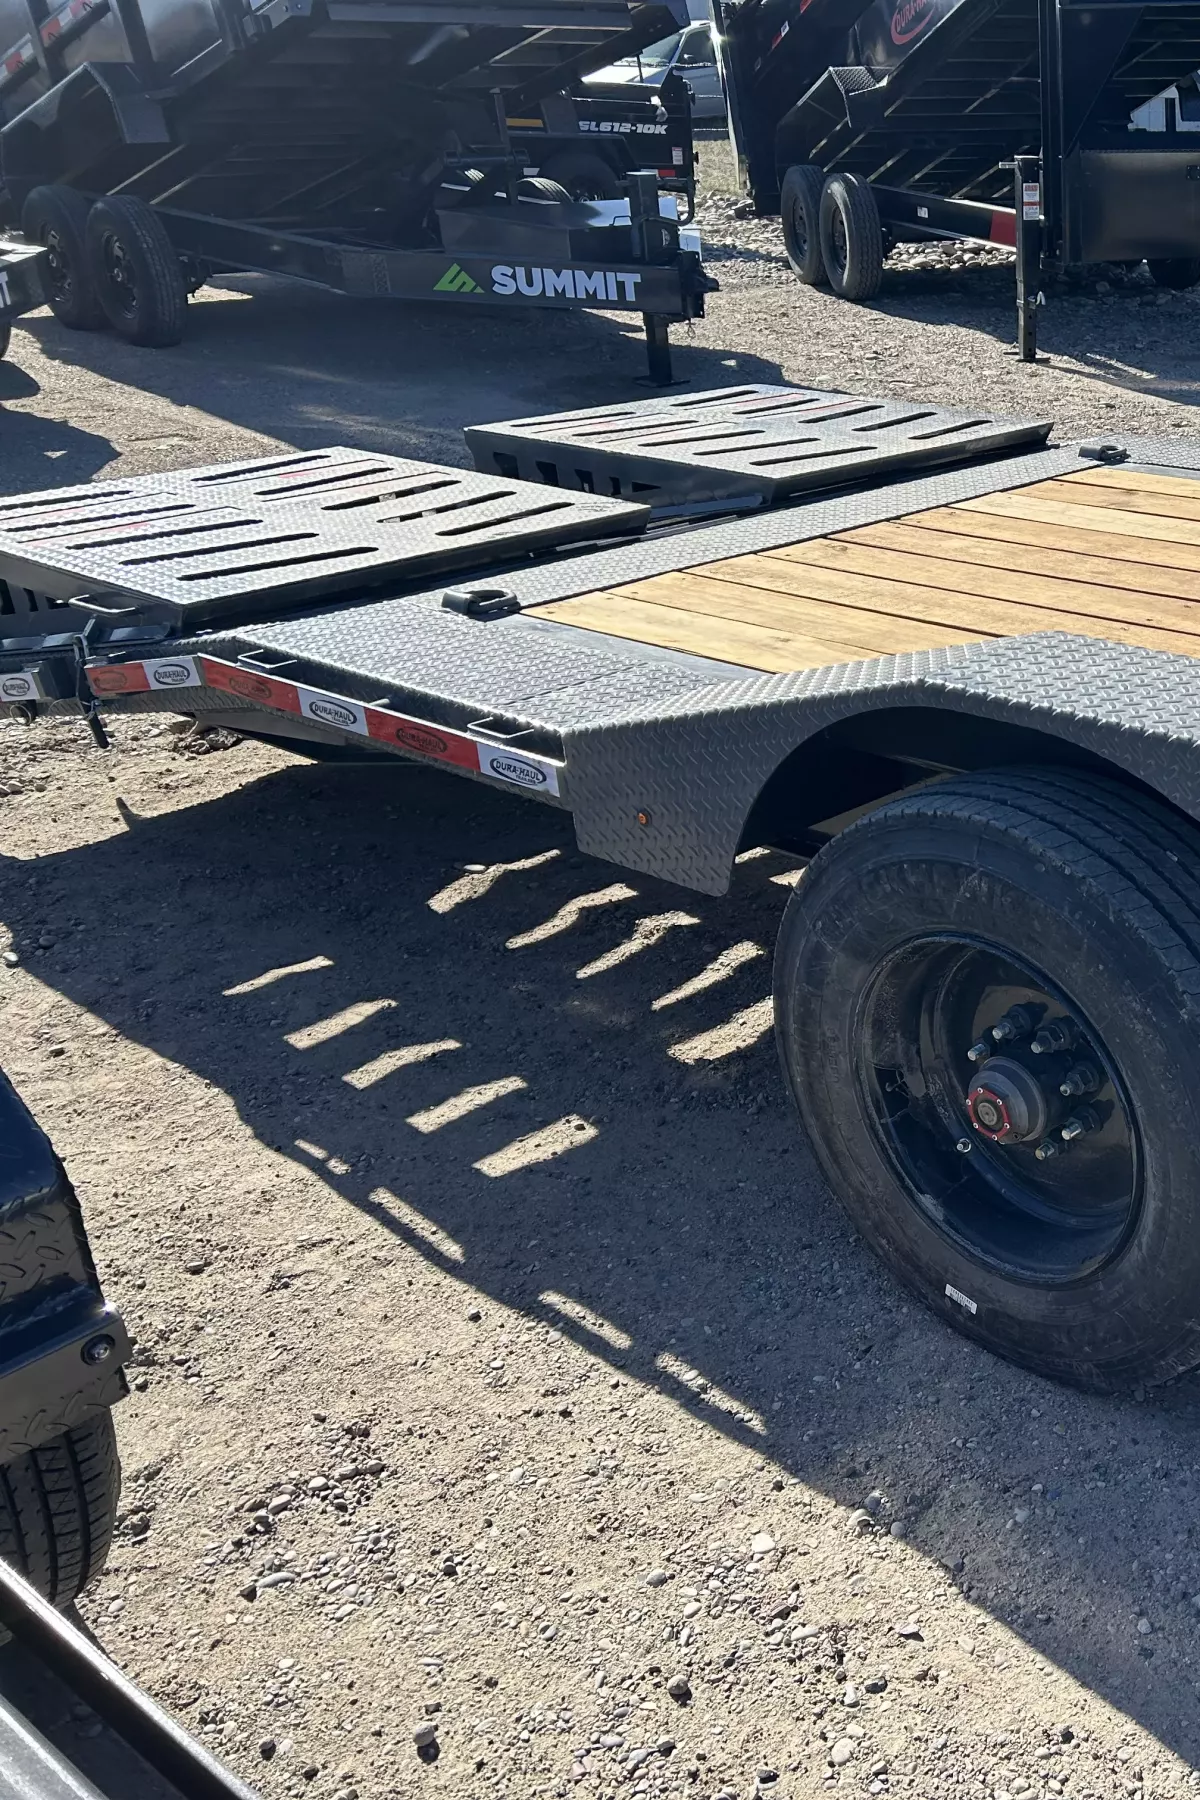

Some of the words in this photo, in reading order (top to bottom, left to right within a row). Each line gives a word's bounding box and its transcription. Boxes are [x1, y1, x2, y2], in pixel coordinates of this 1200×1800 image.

[579, 121, 668, 134] SL612-10K
[491, 265, 641, 301] SUMMIT
[157, 670, 187, 679] DURA-HAUL
[314, 705, 352, 721] DURA-HAUL
[496, 760, 540, 781] DURA-HAUL
